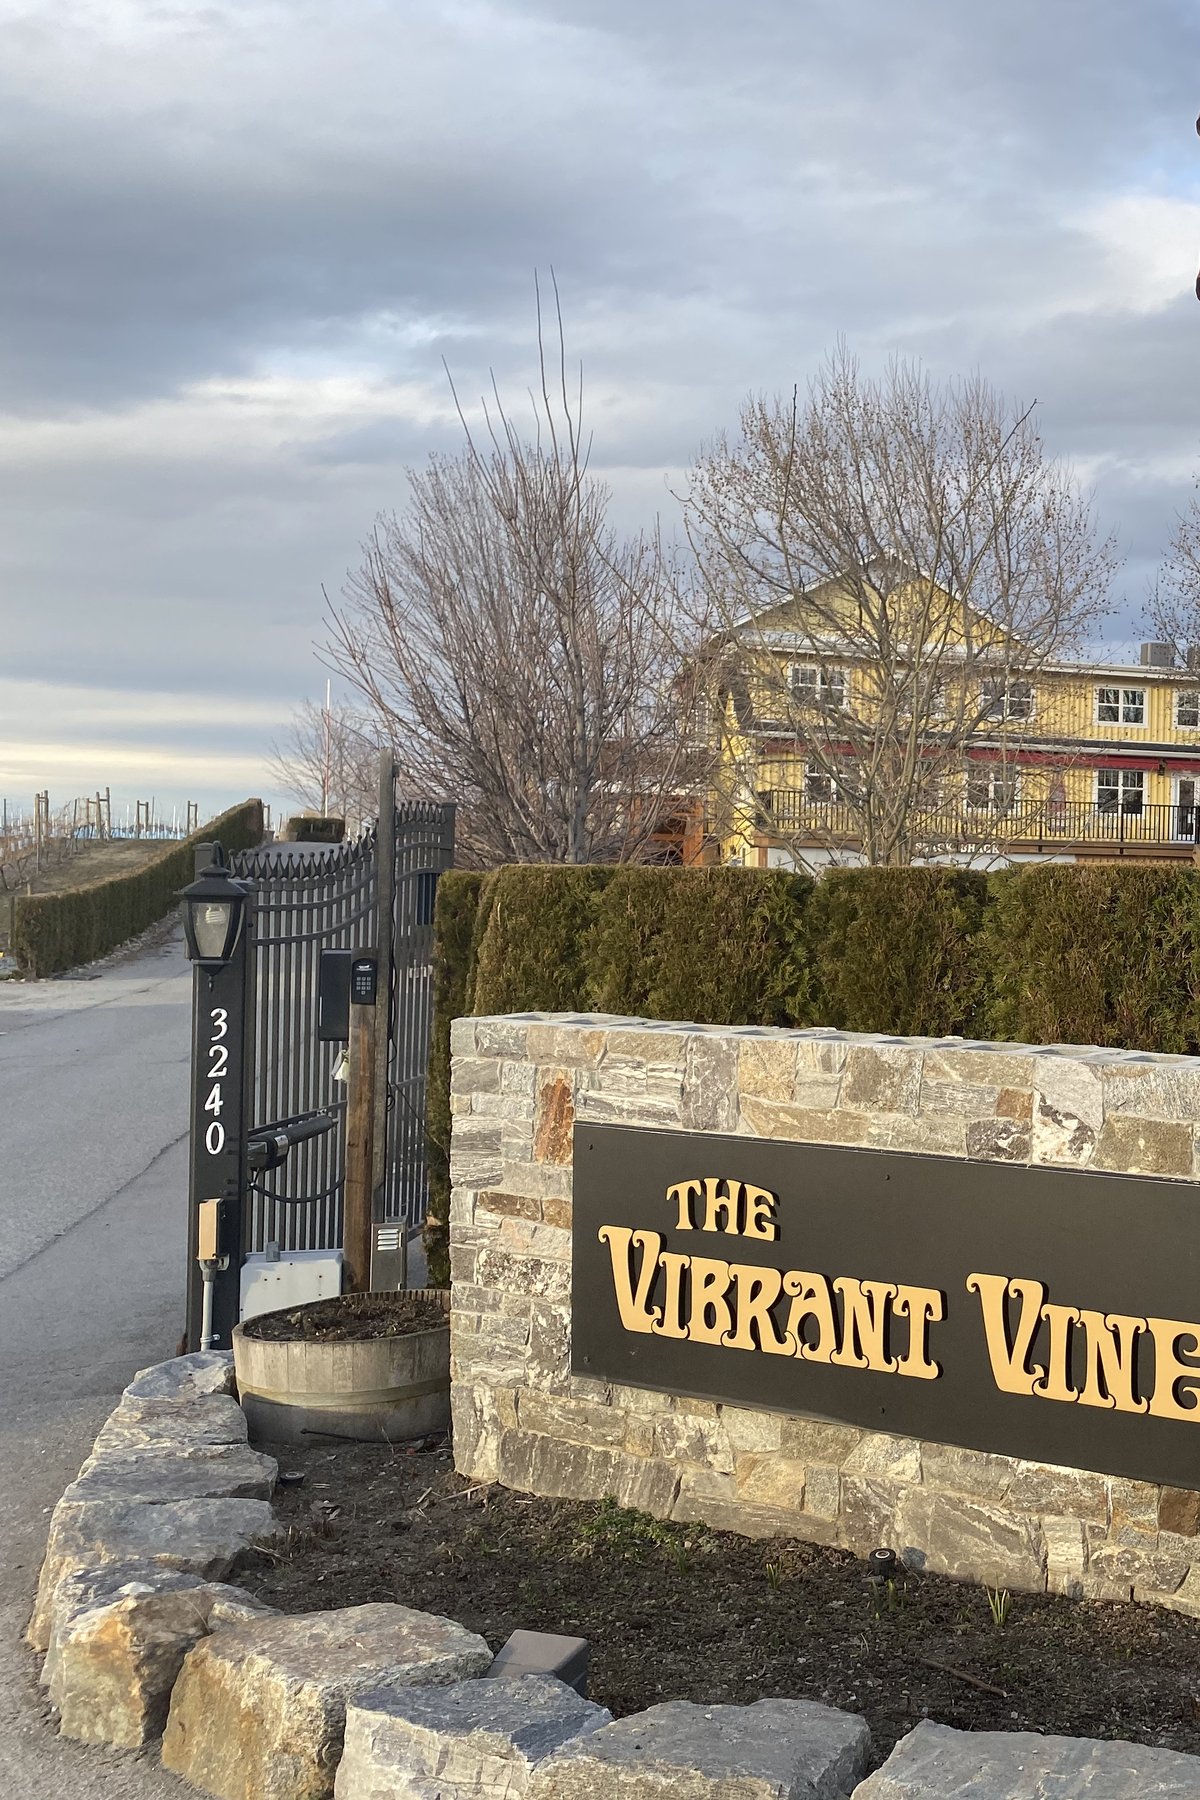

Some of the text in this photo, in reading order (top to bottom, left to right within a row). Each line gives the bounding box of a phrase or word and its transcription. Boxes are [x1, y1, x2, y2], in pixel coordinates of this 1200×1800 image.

[204, 1007, 229, 1155] 3240
[666, 1177, 776, 1242] THE
[598, 1225, 943, 1380] VIBRANT
